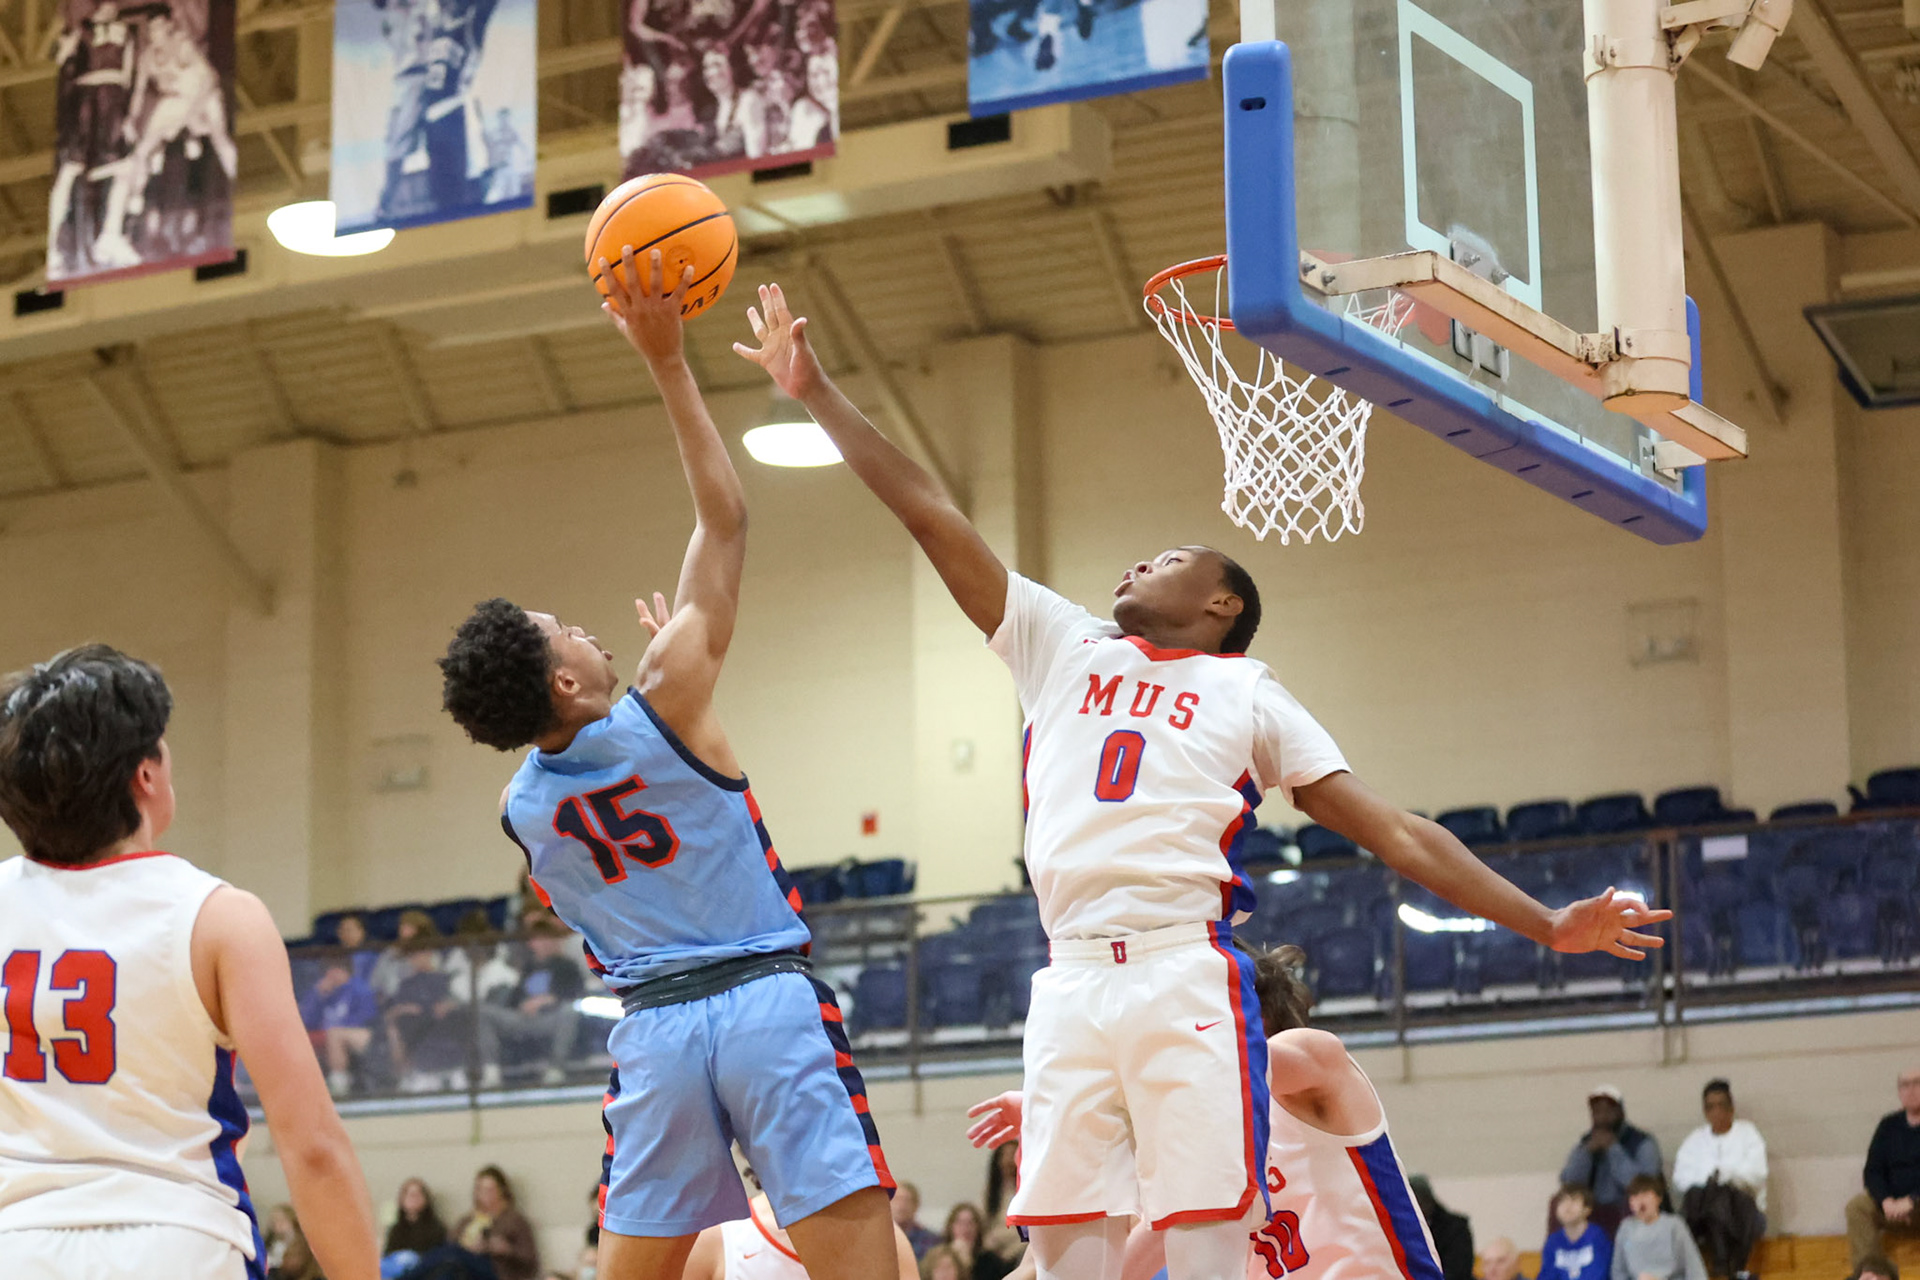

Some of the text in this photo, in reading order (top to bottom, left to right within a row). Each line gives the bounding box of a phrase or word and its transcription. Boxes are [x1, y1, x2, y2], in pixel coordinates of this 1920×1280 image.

[1078, 673, 1200, 730] MUS
[1094, 729, 1146, 802] 0
[552, 774, 681, 884] 15
[1111, 941, 1127, 964] U
[1, 949, 117, 1084] 13
[1250, 1210, 1310, 1279] 10
